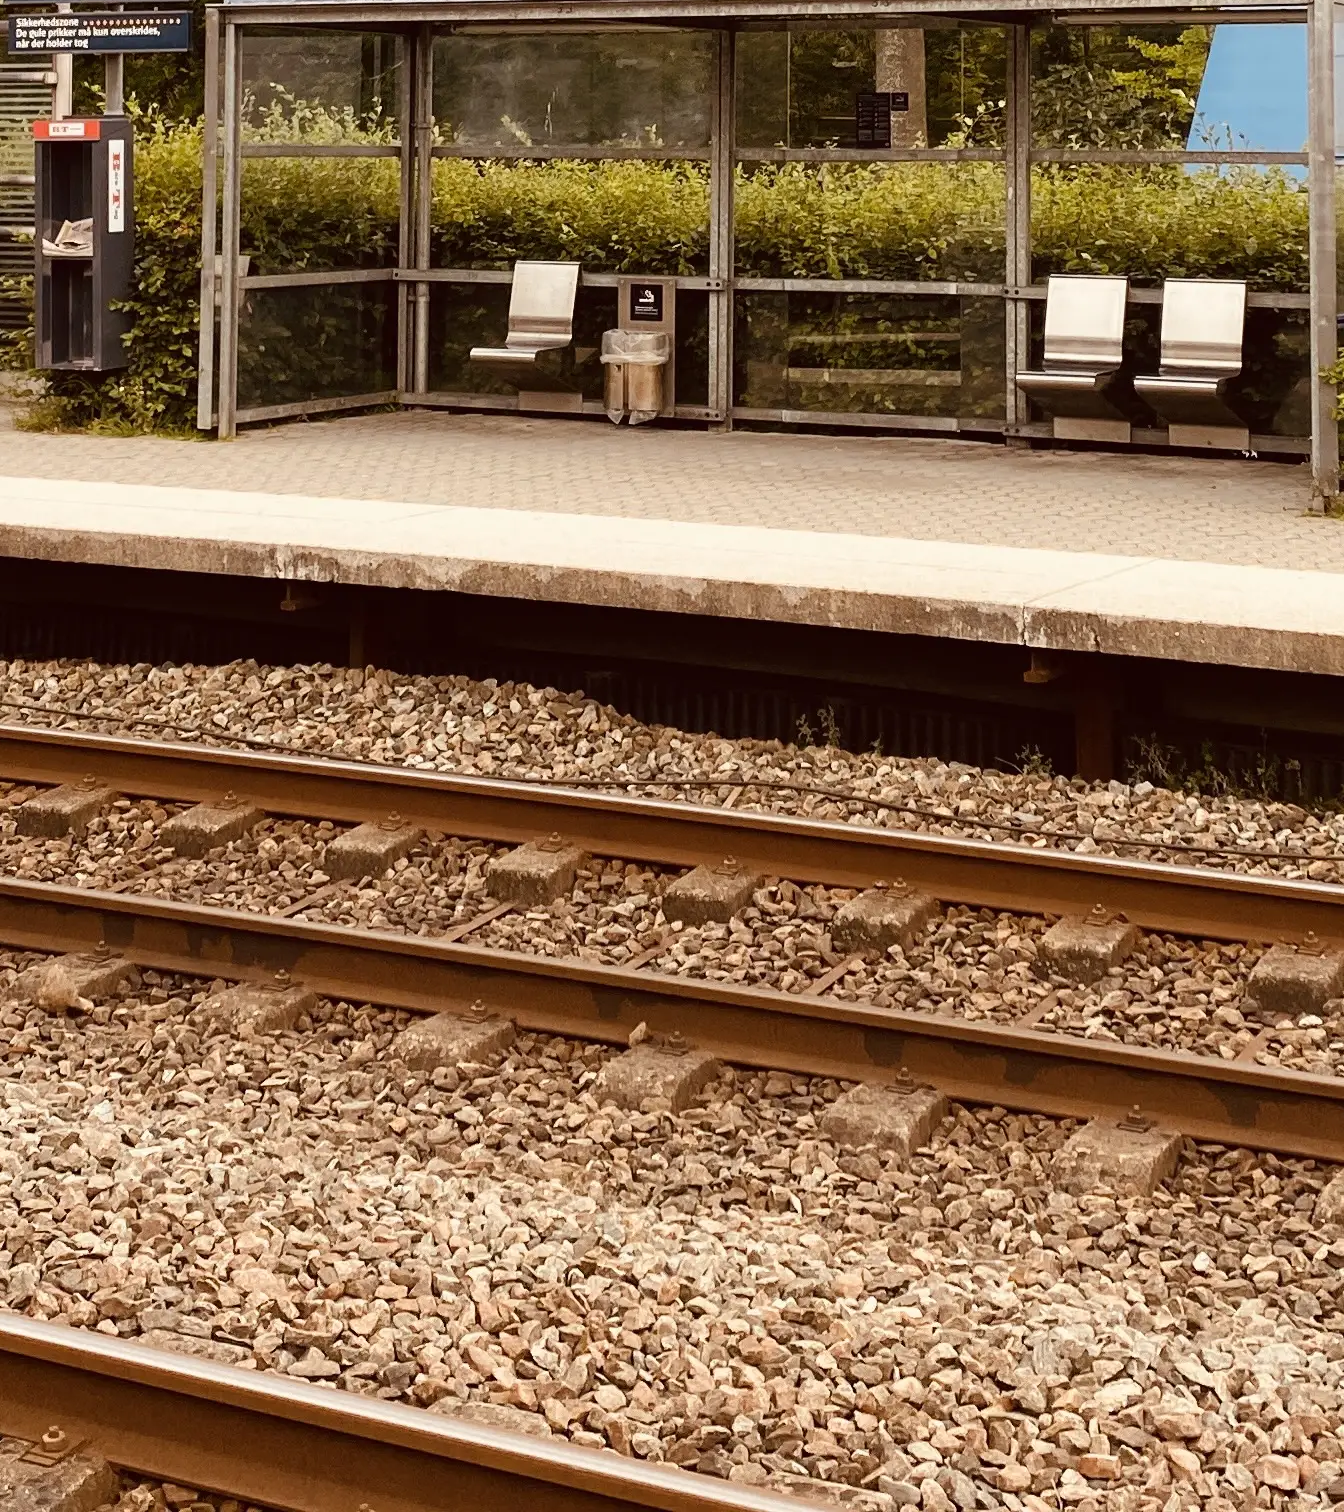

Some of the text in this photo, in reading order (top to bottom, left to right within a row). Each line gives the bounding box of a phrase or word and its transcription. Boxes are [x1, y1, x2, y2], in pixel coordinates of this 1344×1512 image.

[16, 17, 79, 27] Sikkerhedszone
[16, 25, 161, 39] De gule prikker må kun overskrides,
[31, 39, 45, 48] der
[46, 38, 73, 47] holder
[74, 39, 89, 48] tog
